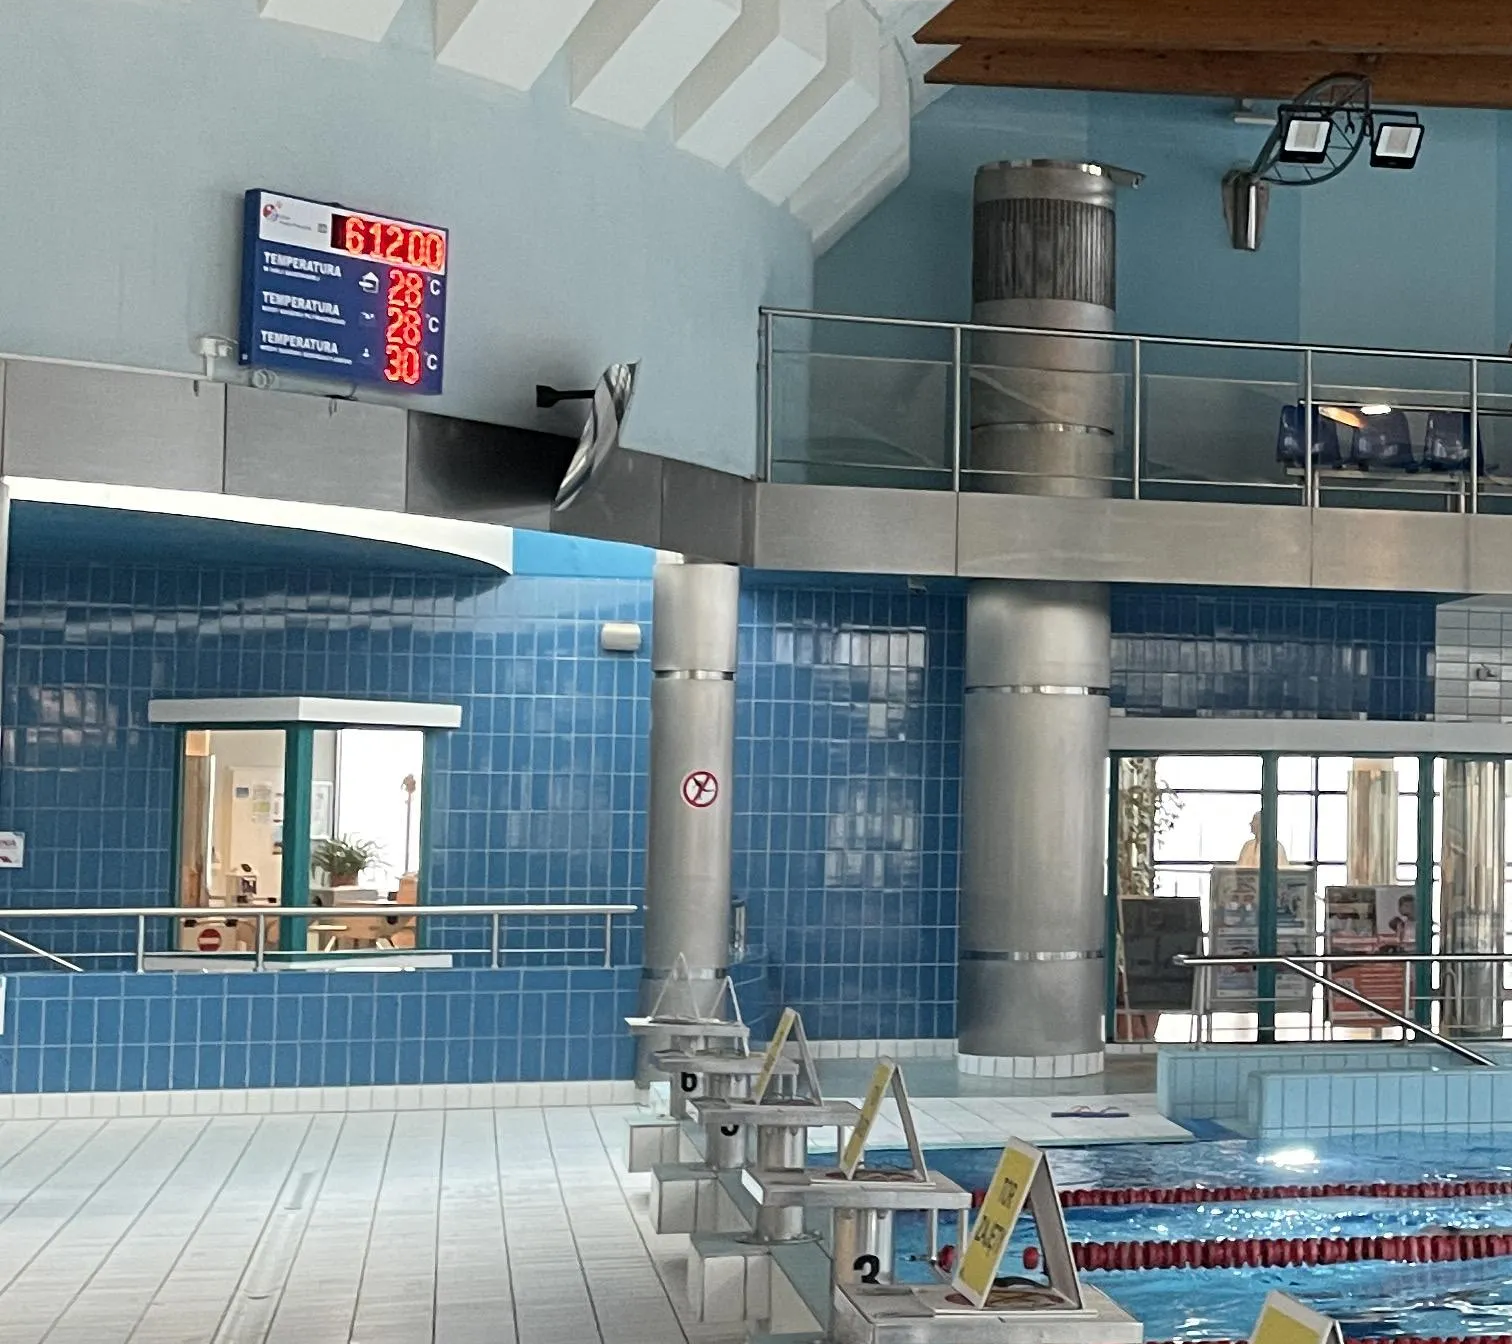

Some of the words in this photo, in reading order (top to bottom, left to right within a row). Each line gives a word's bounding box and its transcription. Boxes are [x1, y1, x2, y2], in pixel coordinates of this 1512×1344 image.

[263, 251, 341, 277] TEMPERATURA
[388, 269, 423, 309] 28
[262, 291, 340, 316] TEMPERATURA
[387, 306, 422, 346] 28
[260, 330, 338, 354] TEMPERATURA
[384, 345, 420, 384] 30
